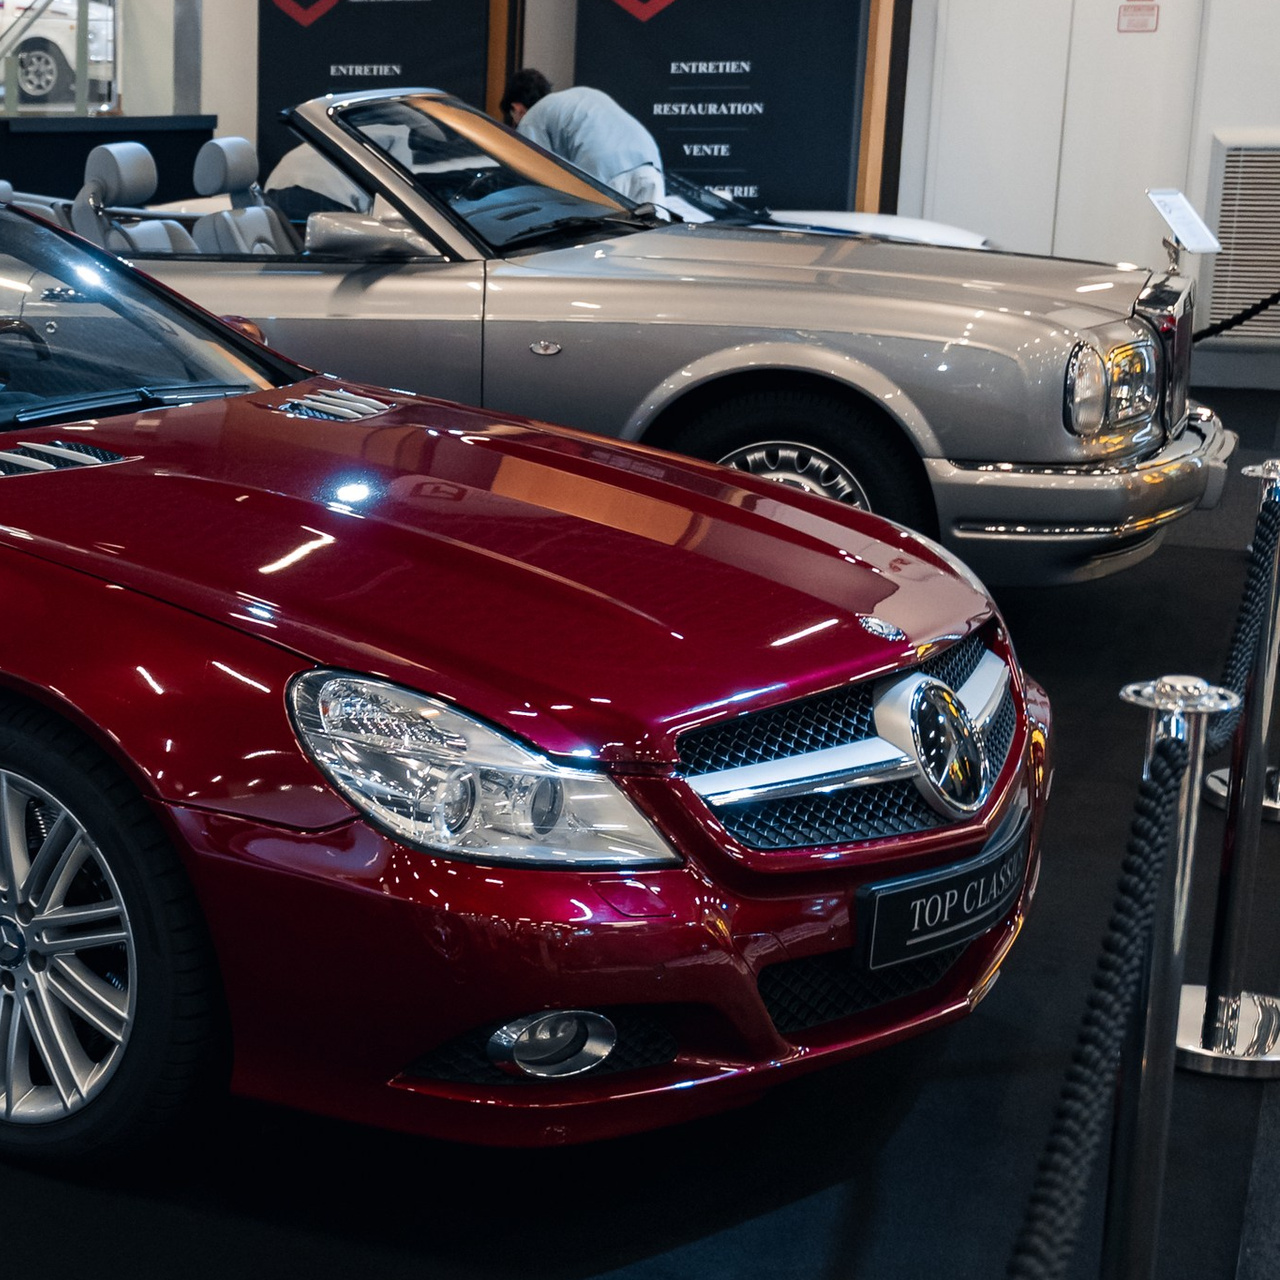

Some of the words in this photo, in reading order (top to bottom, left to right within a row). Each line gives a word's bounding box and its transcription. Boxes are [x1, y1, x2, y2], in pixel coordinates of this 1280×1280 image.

[329, 64, 402, 76] ENTRETIEN
[670, 61, 752, 74] ENTRETIEN
[652, 103, 765, 115] RESTAURATION
[682, 144, 731, 156] VENTE
[910, 889, 958, 932] TOP
